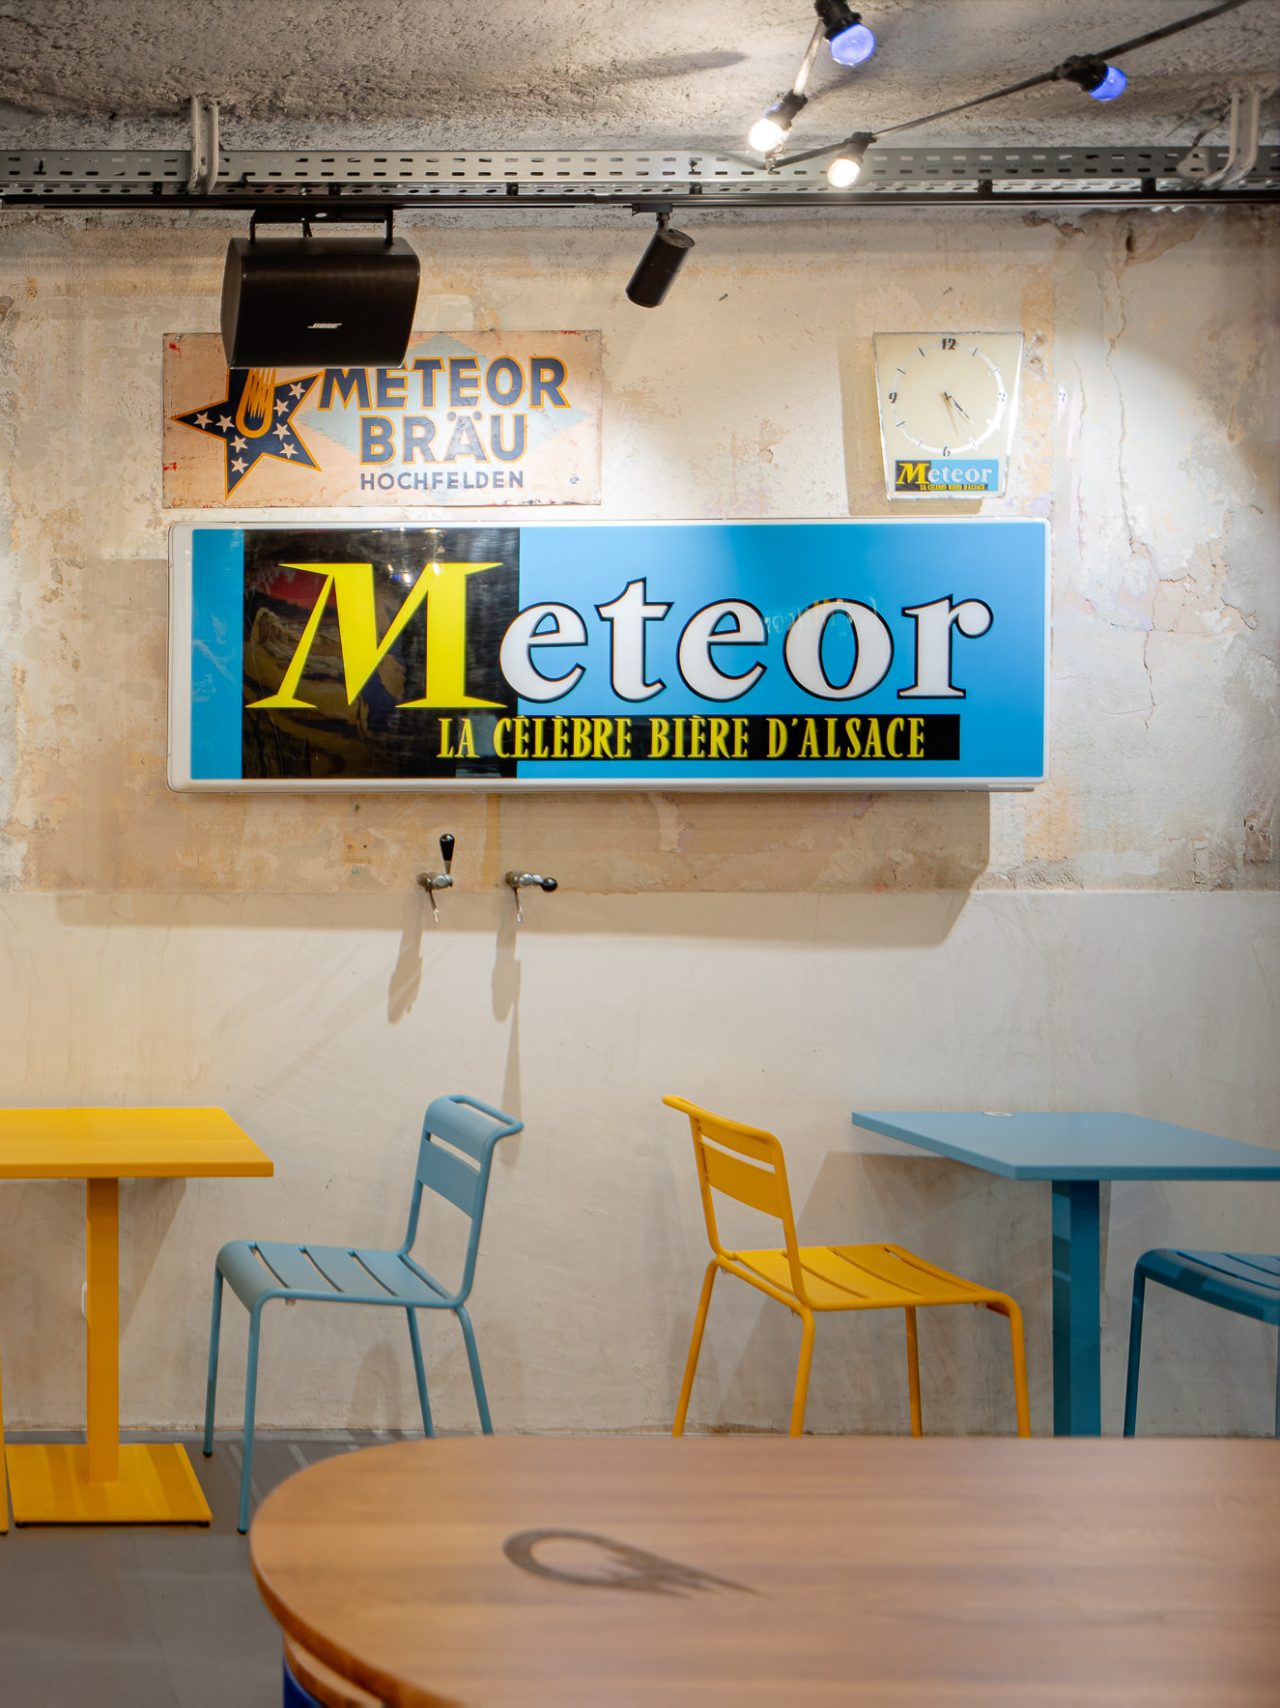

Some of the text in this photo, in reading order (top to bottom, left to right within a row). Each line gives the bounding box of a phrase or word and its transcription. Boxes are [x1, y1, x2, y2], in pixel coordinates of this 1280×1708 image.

[941, 338, 956, 350] 12
[317, 356, 571, 410] METEOR
[888, 391, 897, 404] 9
[359, 411, 528, 466] BRÄU
[360, 470, 524, 491] HOCHFELDEN
[896, 462, 993, 485] Meteor
[245, 562, 994, 710] Meteor
[438, 713, 925, 759] LA CÉLÈBRE BIÈRE D'ALSACE
